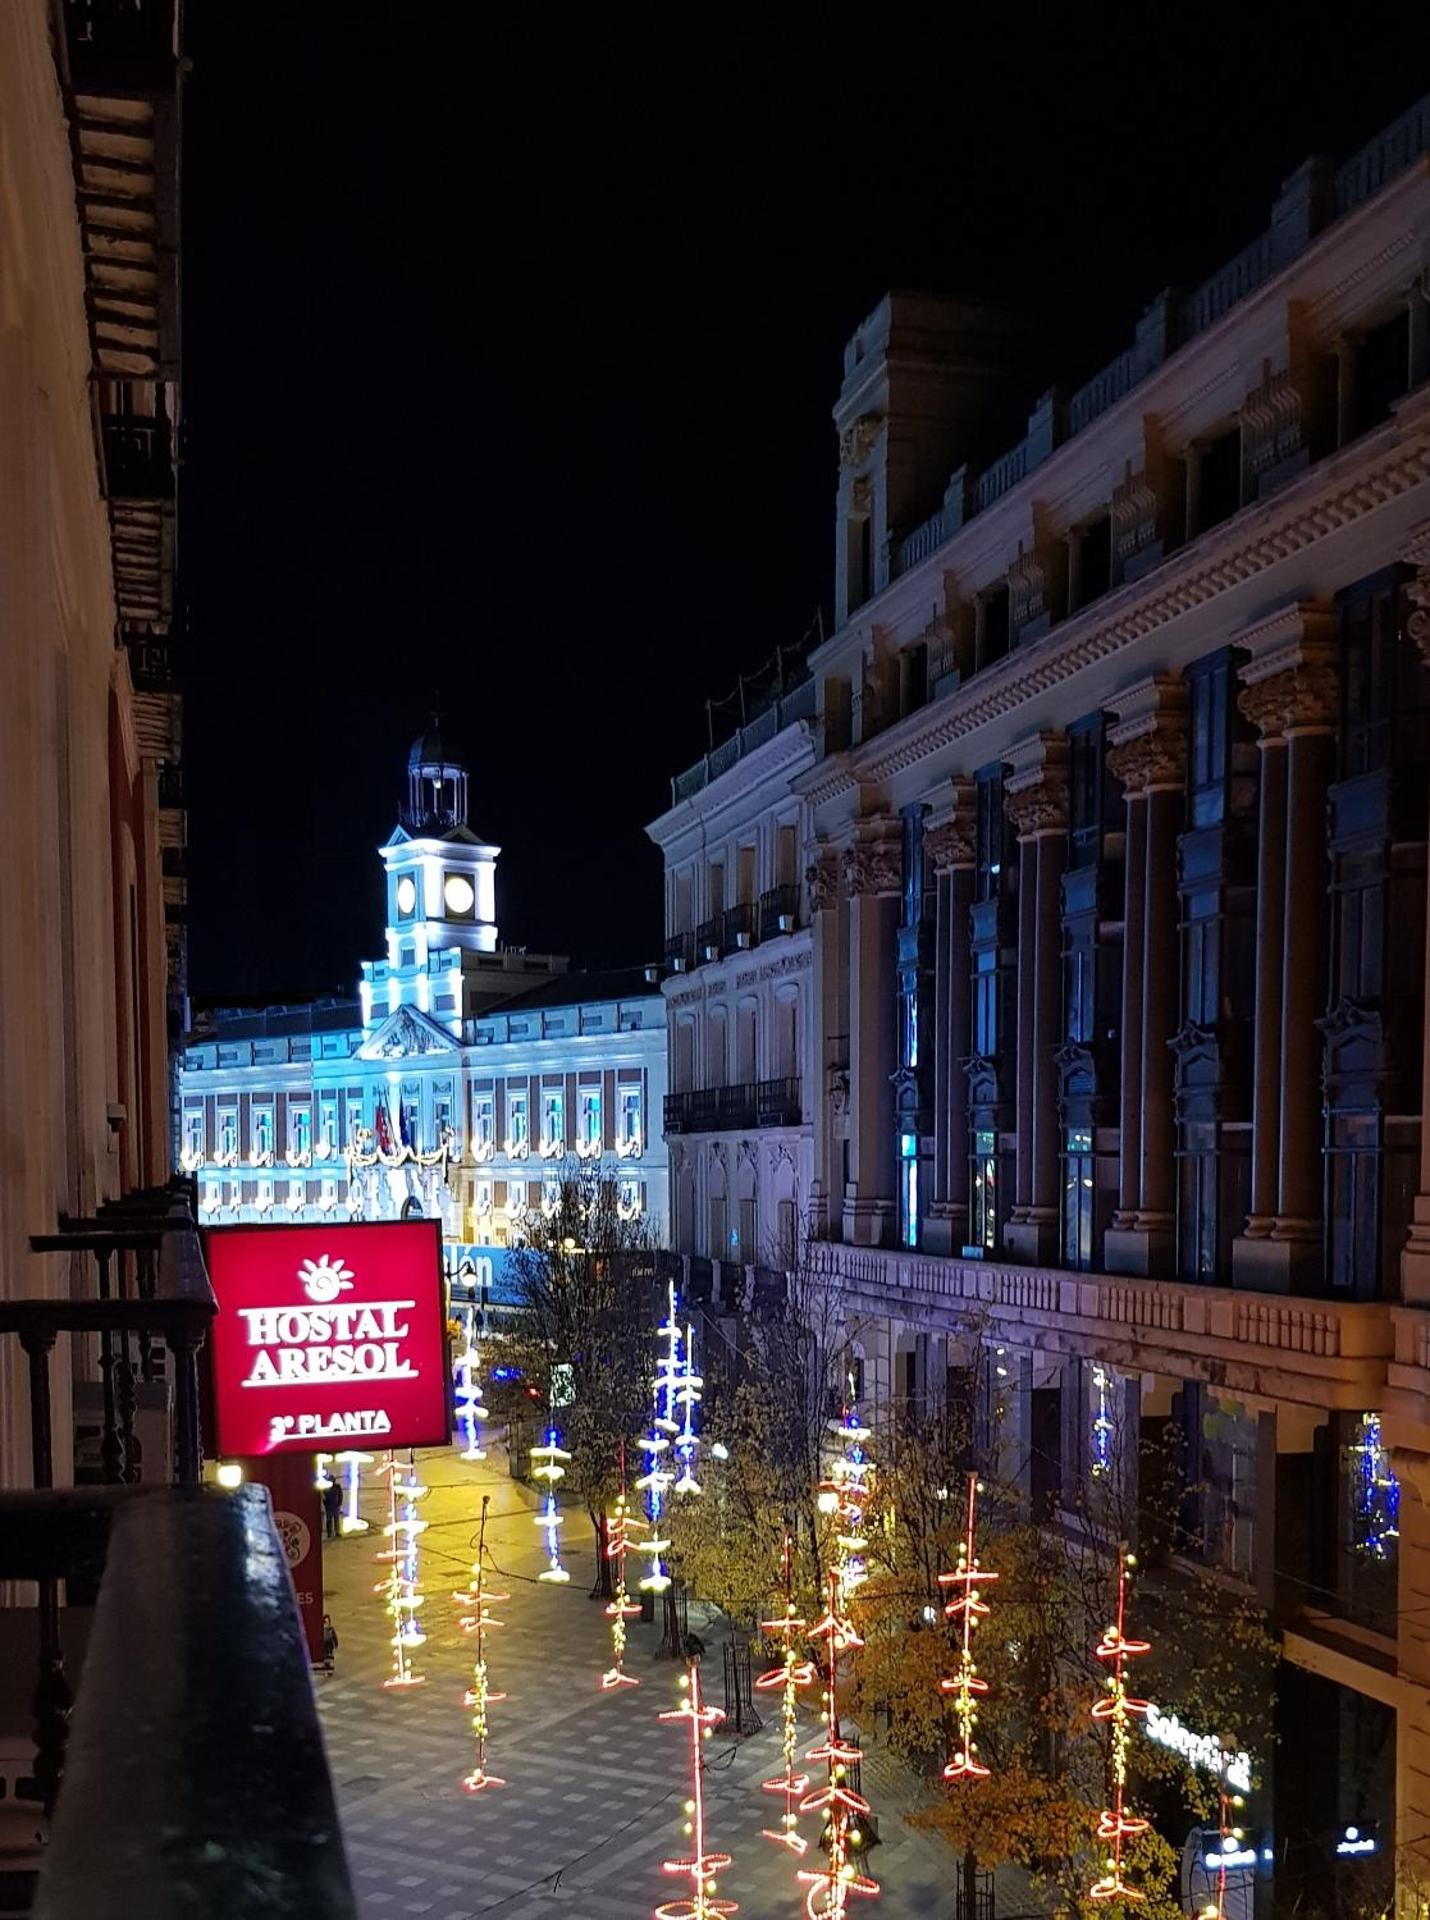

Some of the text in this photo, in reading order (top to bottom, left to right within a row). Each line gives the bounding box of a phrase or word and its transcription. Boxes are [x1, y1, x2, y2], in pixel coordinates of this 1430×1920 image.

[247, 1305, 409, 1345] HOSTAL
[250, 1342, 411, 1381] ARESOL
[298, 1409, 391, 1435] PLANTA
